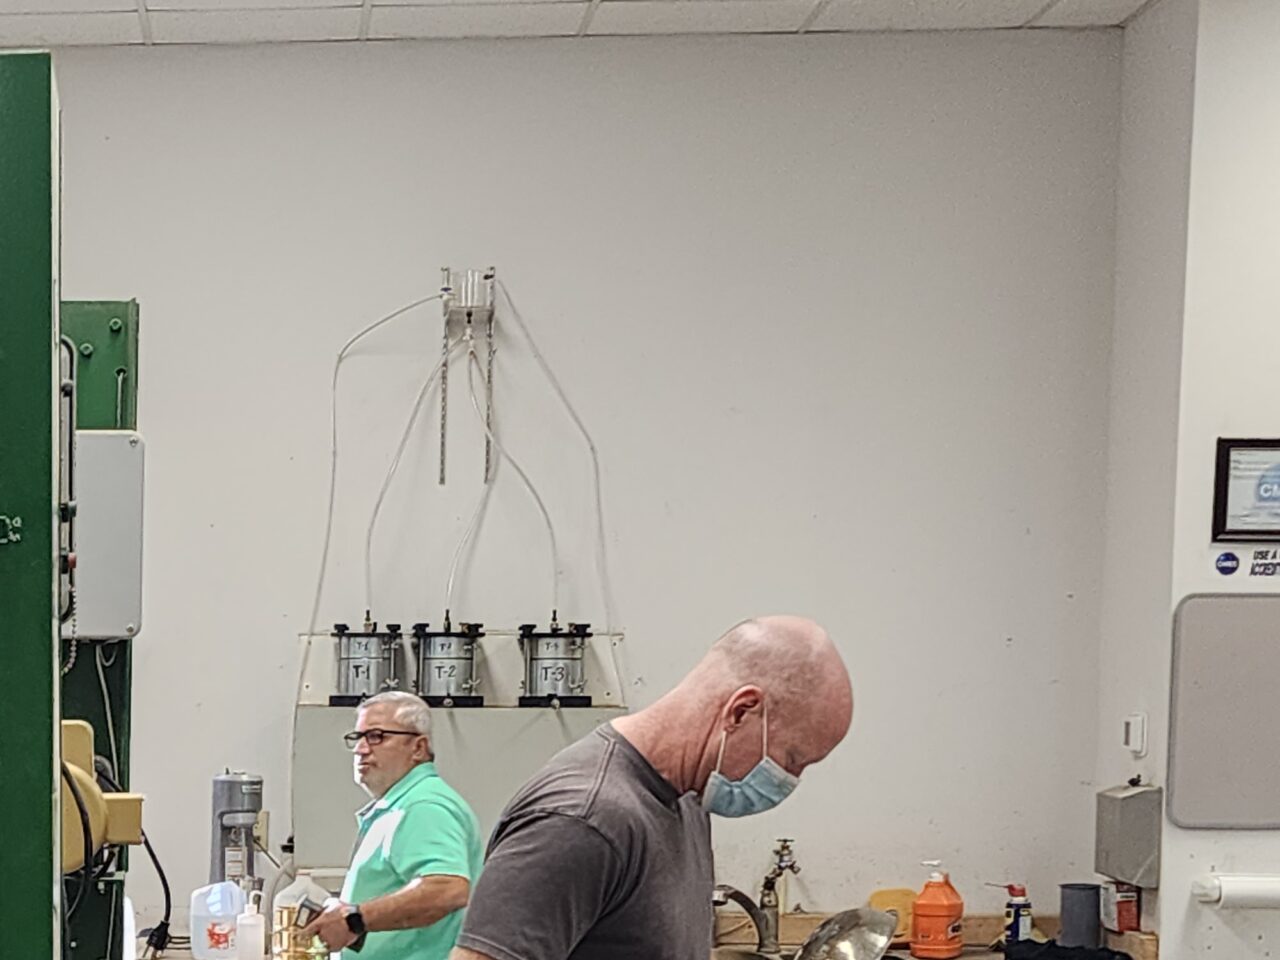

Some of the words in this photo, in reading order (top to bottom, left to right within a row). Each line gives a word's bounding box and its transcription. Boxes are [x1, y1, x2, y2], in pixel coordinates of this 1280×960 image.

[352, 664, 370, 681] T-1
[434, 664, 457, 680] T-2
[541, 666, 565, 682] T-3
